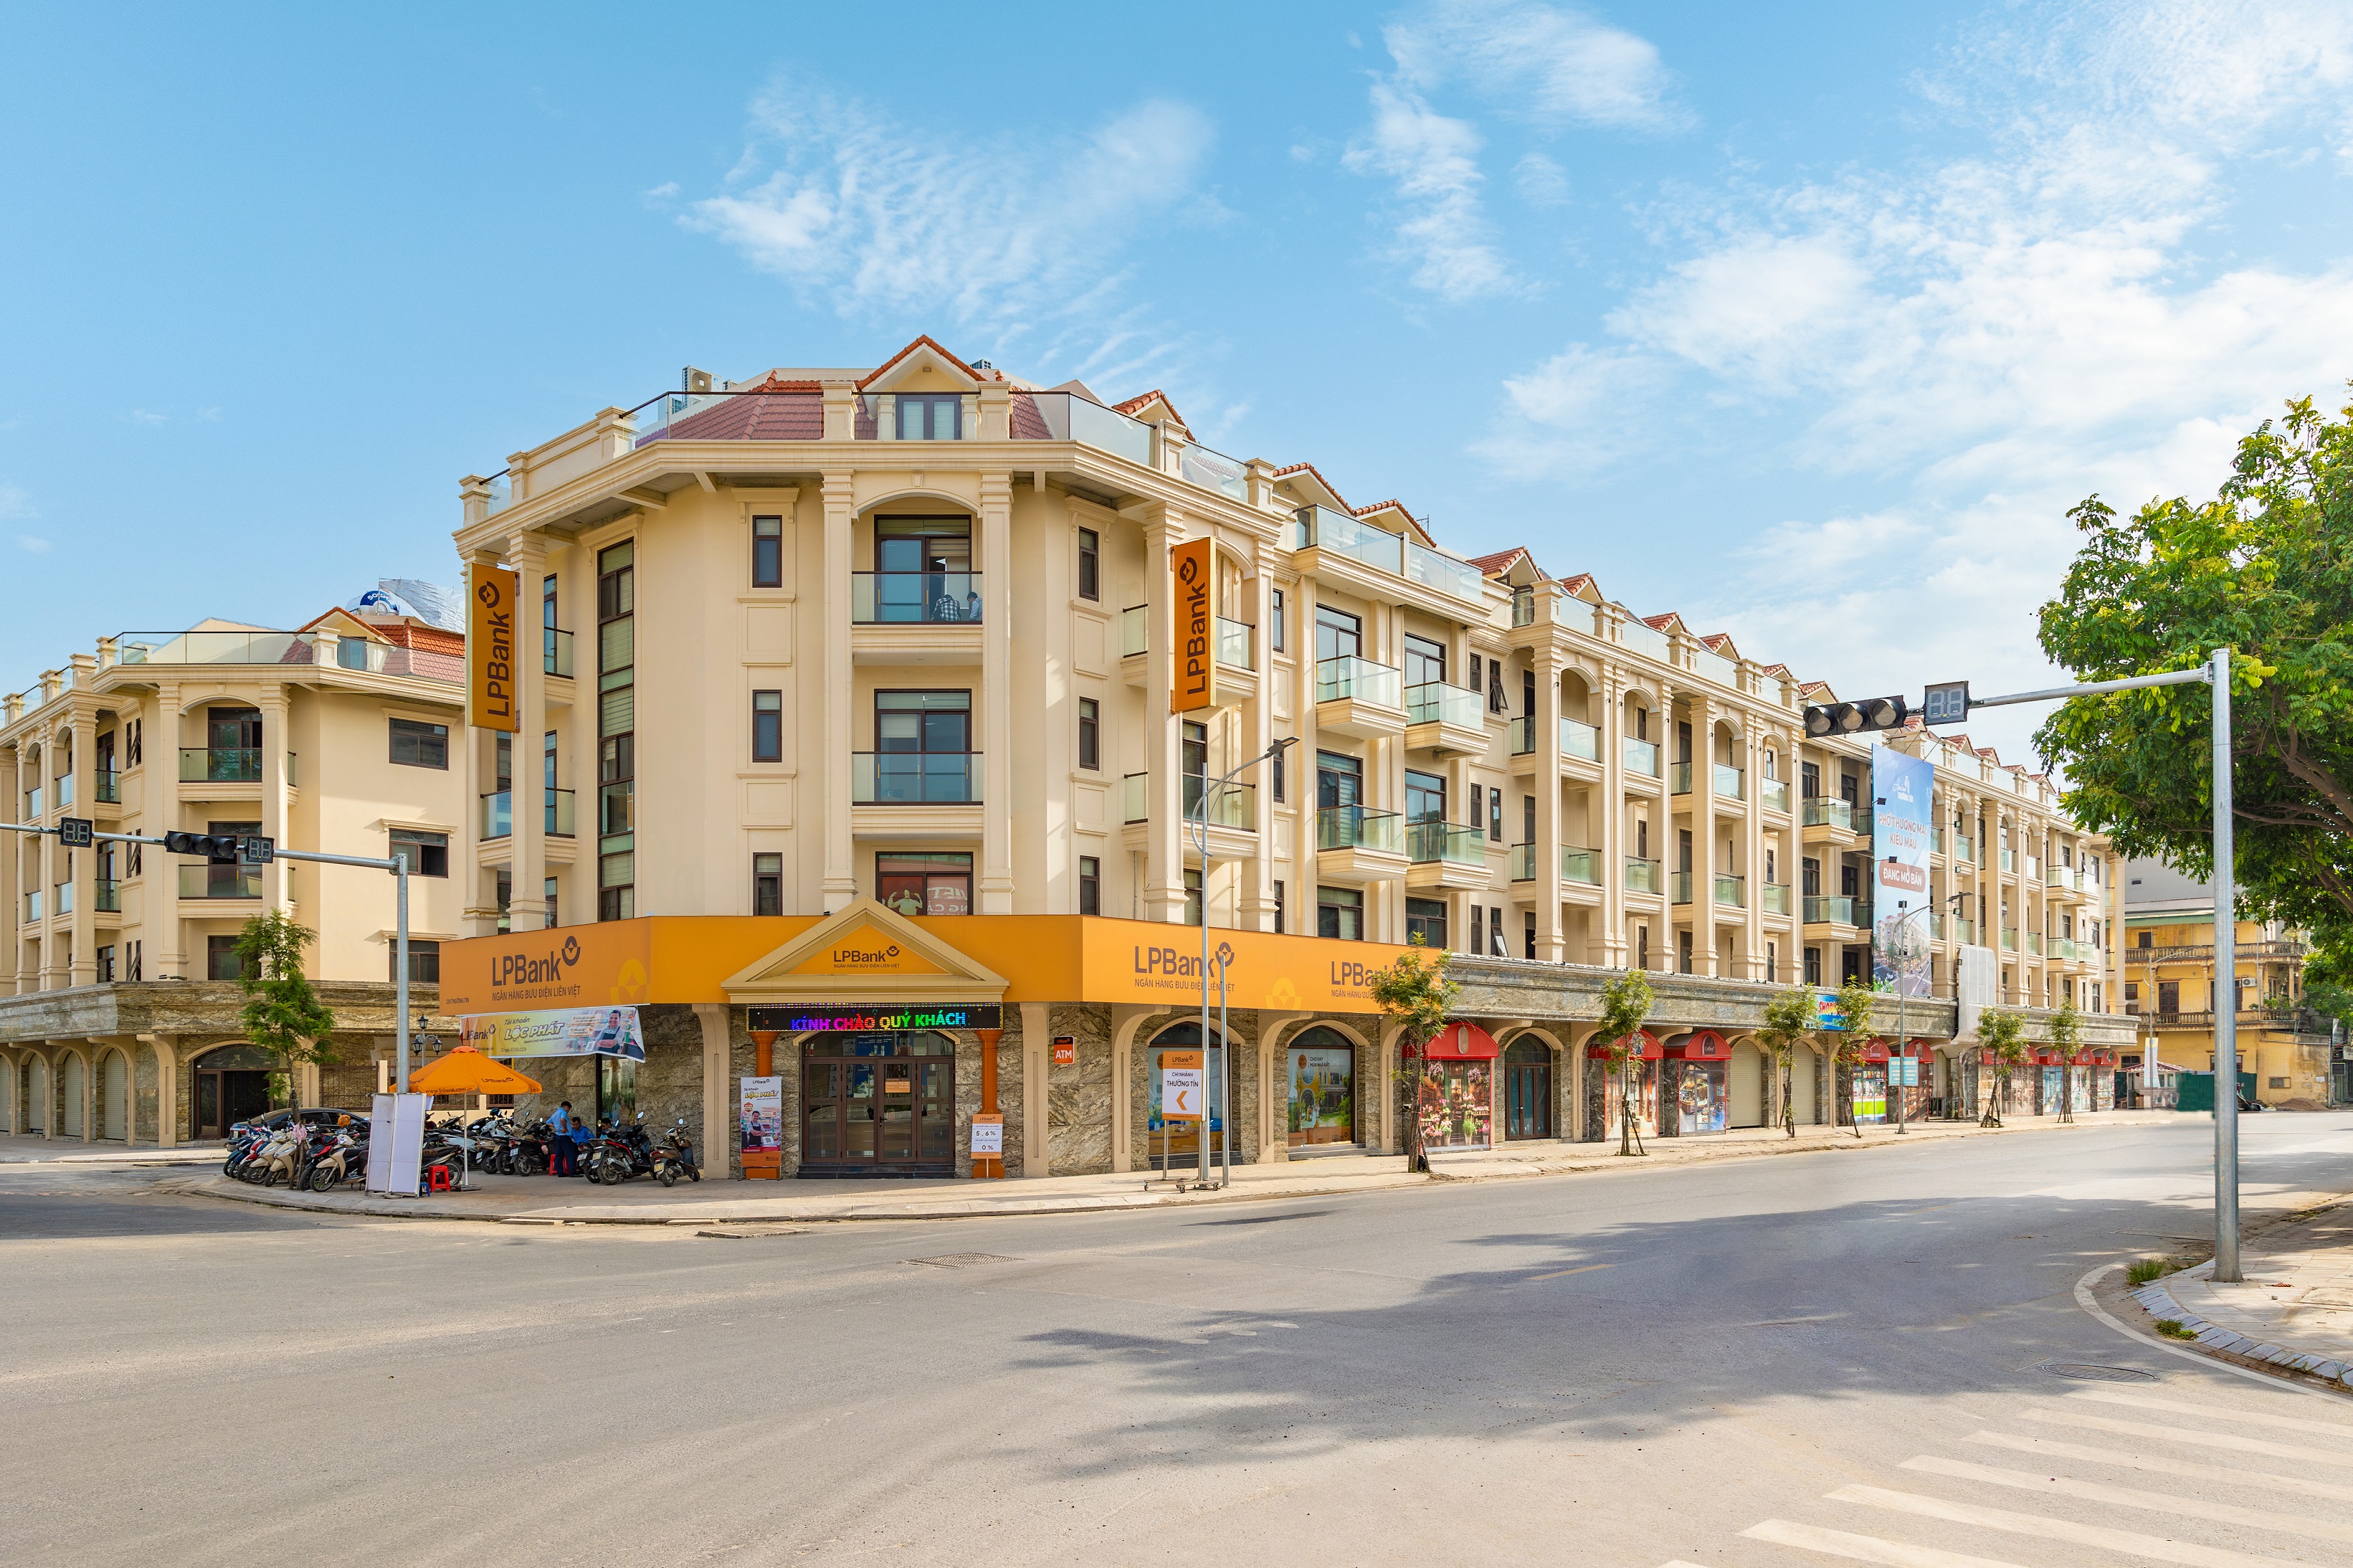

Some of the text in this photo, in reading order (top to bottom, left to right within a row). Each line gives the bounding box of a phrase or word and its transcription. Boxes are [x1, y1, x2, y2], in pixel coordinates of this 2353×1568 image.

[1187, 581, 1205, 695] LPBank
[488, 611, 509, 717] LPBank
[1878, 812, 1927, 838] PHỐ THƯƠNG MẠI
[1883, 868, 1922, 886] ĐANG MỞ BÁN
[834, 950, 886, 962] LPBank
[492, 951, 561, 987] LPBank
[492, 984, 581, 1002] NGÂN HÀNG BƯU ĐIỆN LIÊN VIỆT
[1134, 977, 1154, 987] NGÂN
[1155, 978, 1174, 989] HÀNG
[1175, 980, 1189, 989] BƯU
[1191, 980, 1203, 992] ĐIỆ
[1331, 989, 1346, 997] NGÂN
[791, 1015, 830, 1030] KÍNH
[833, 1013, 875, 1030] CHÀO
[915, 1009, 966, 1027] KHÁCH
[504, 1021, 565, 1042] LỘC PHÁT
[1055, 1050, 1072, 1059] ATM
